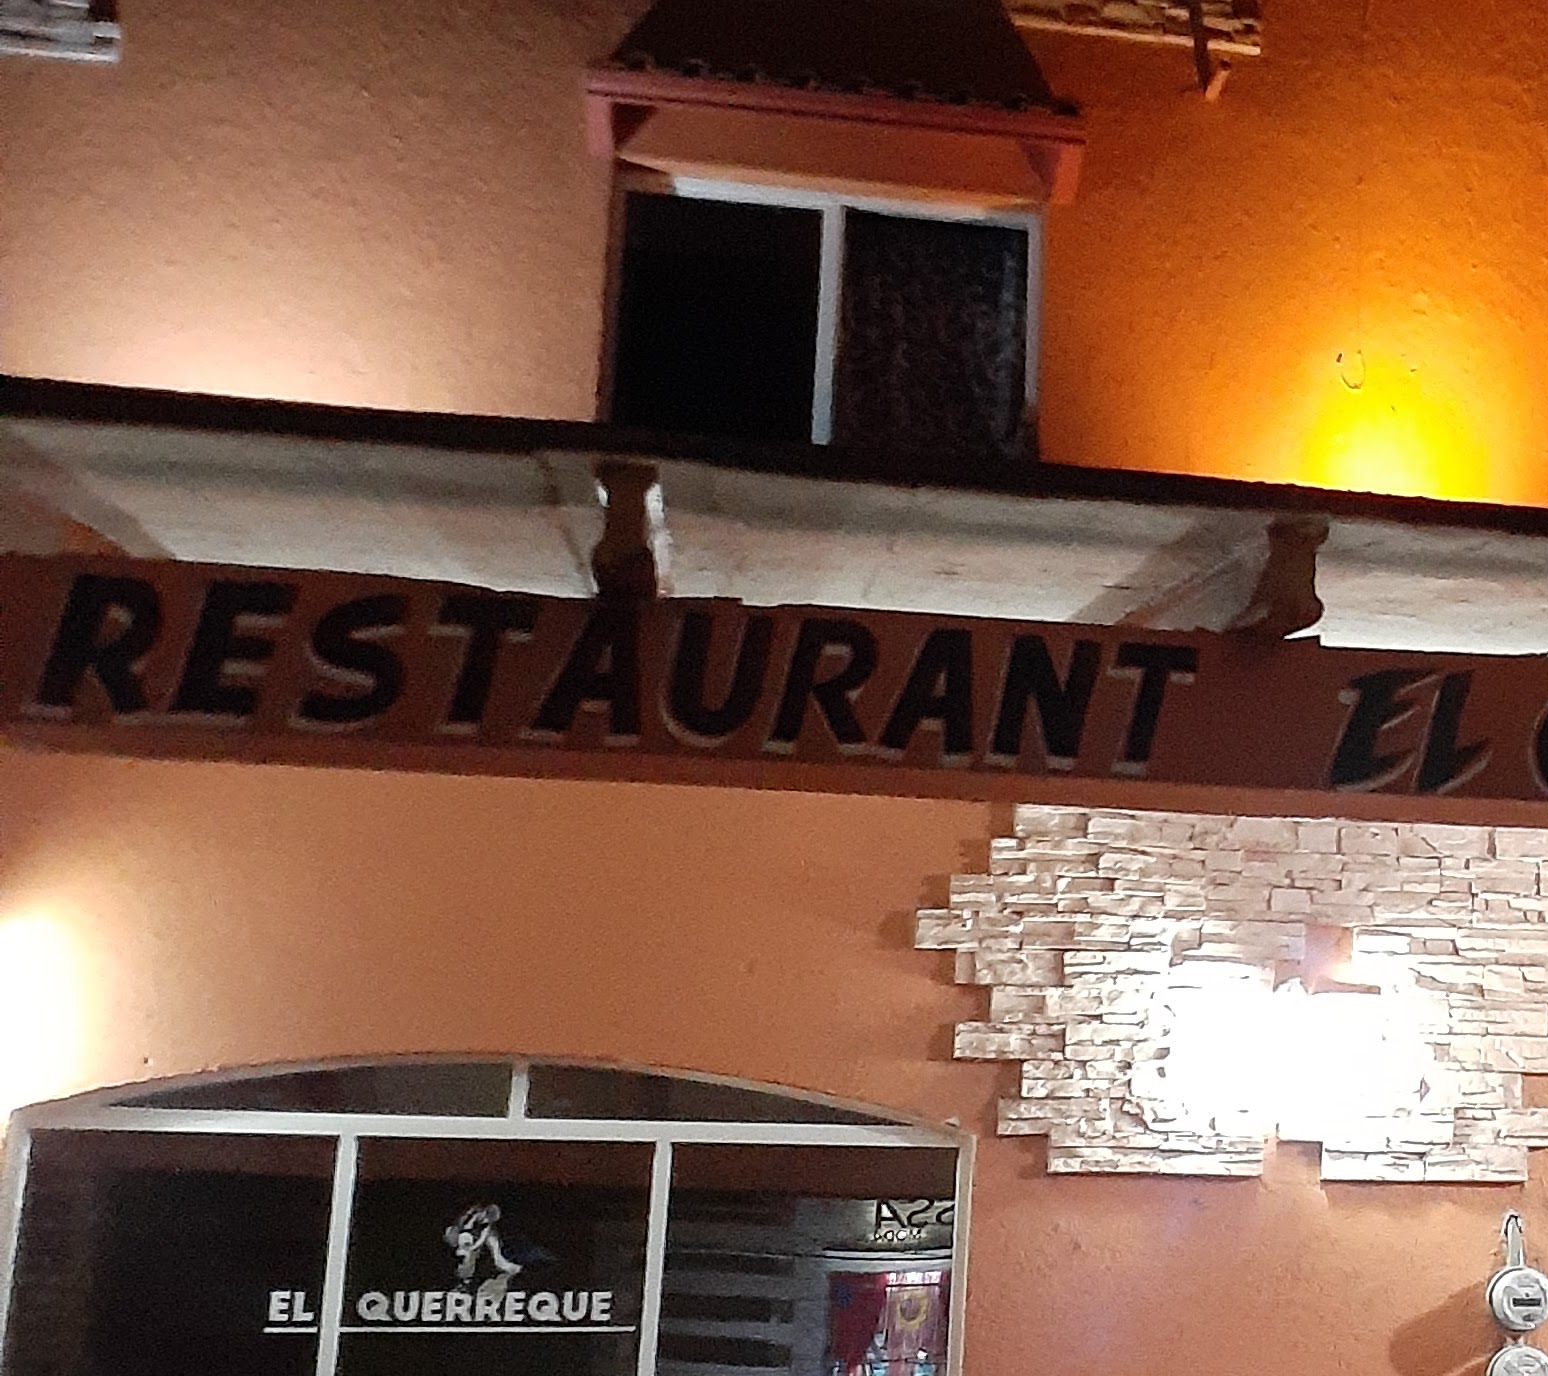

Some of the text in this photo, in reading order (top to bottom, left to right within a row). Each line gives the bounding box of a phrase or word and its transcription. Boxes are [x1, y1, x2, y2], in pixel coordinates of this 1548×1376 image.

[18, 572, 1197, 776] RESTAURANT
[1329, 667, 1493, 795] EL
[268, 1290, 614, 1323] EL QUERREQUE
